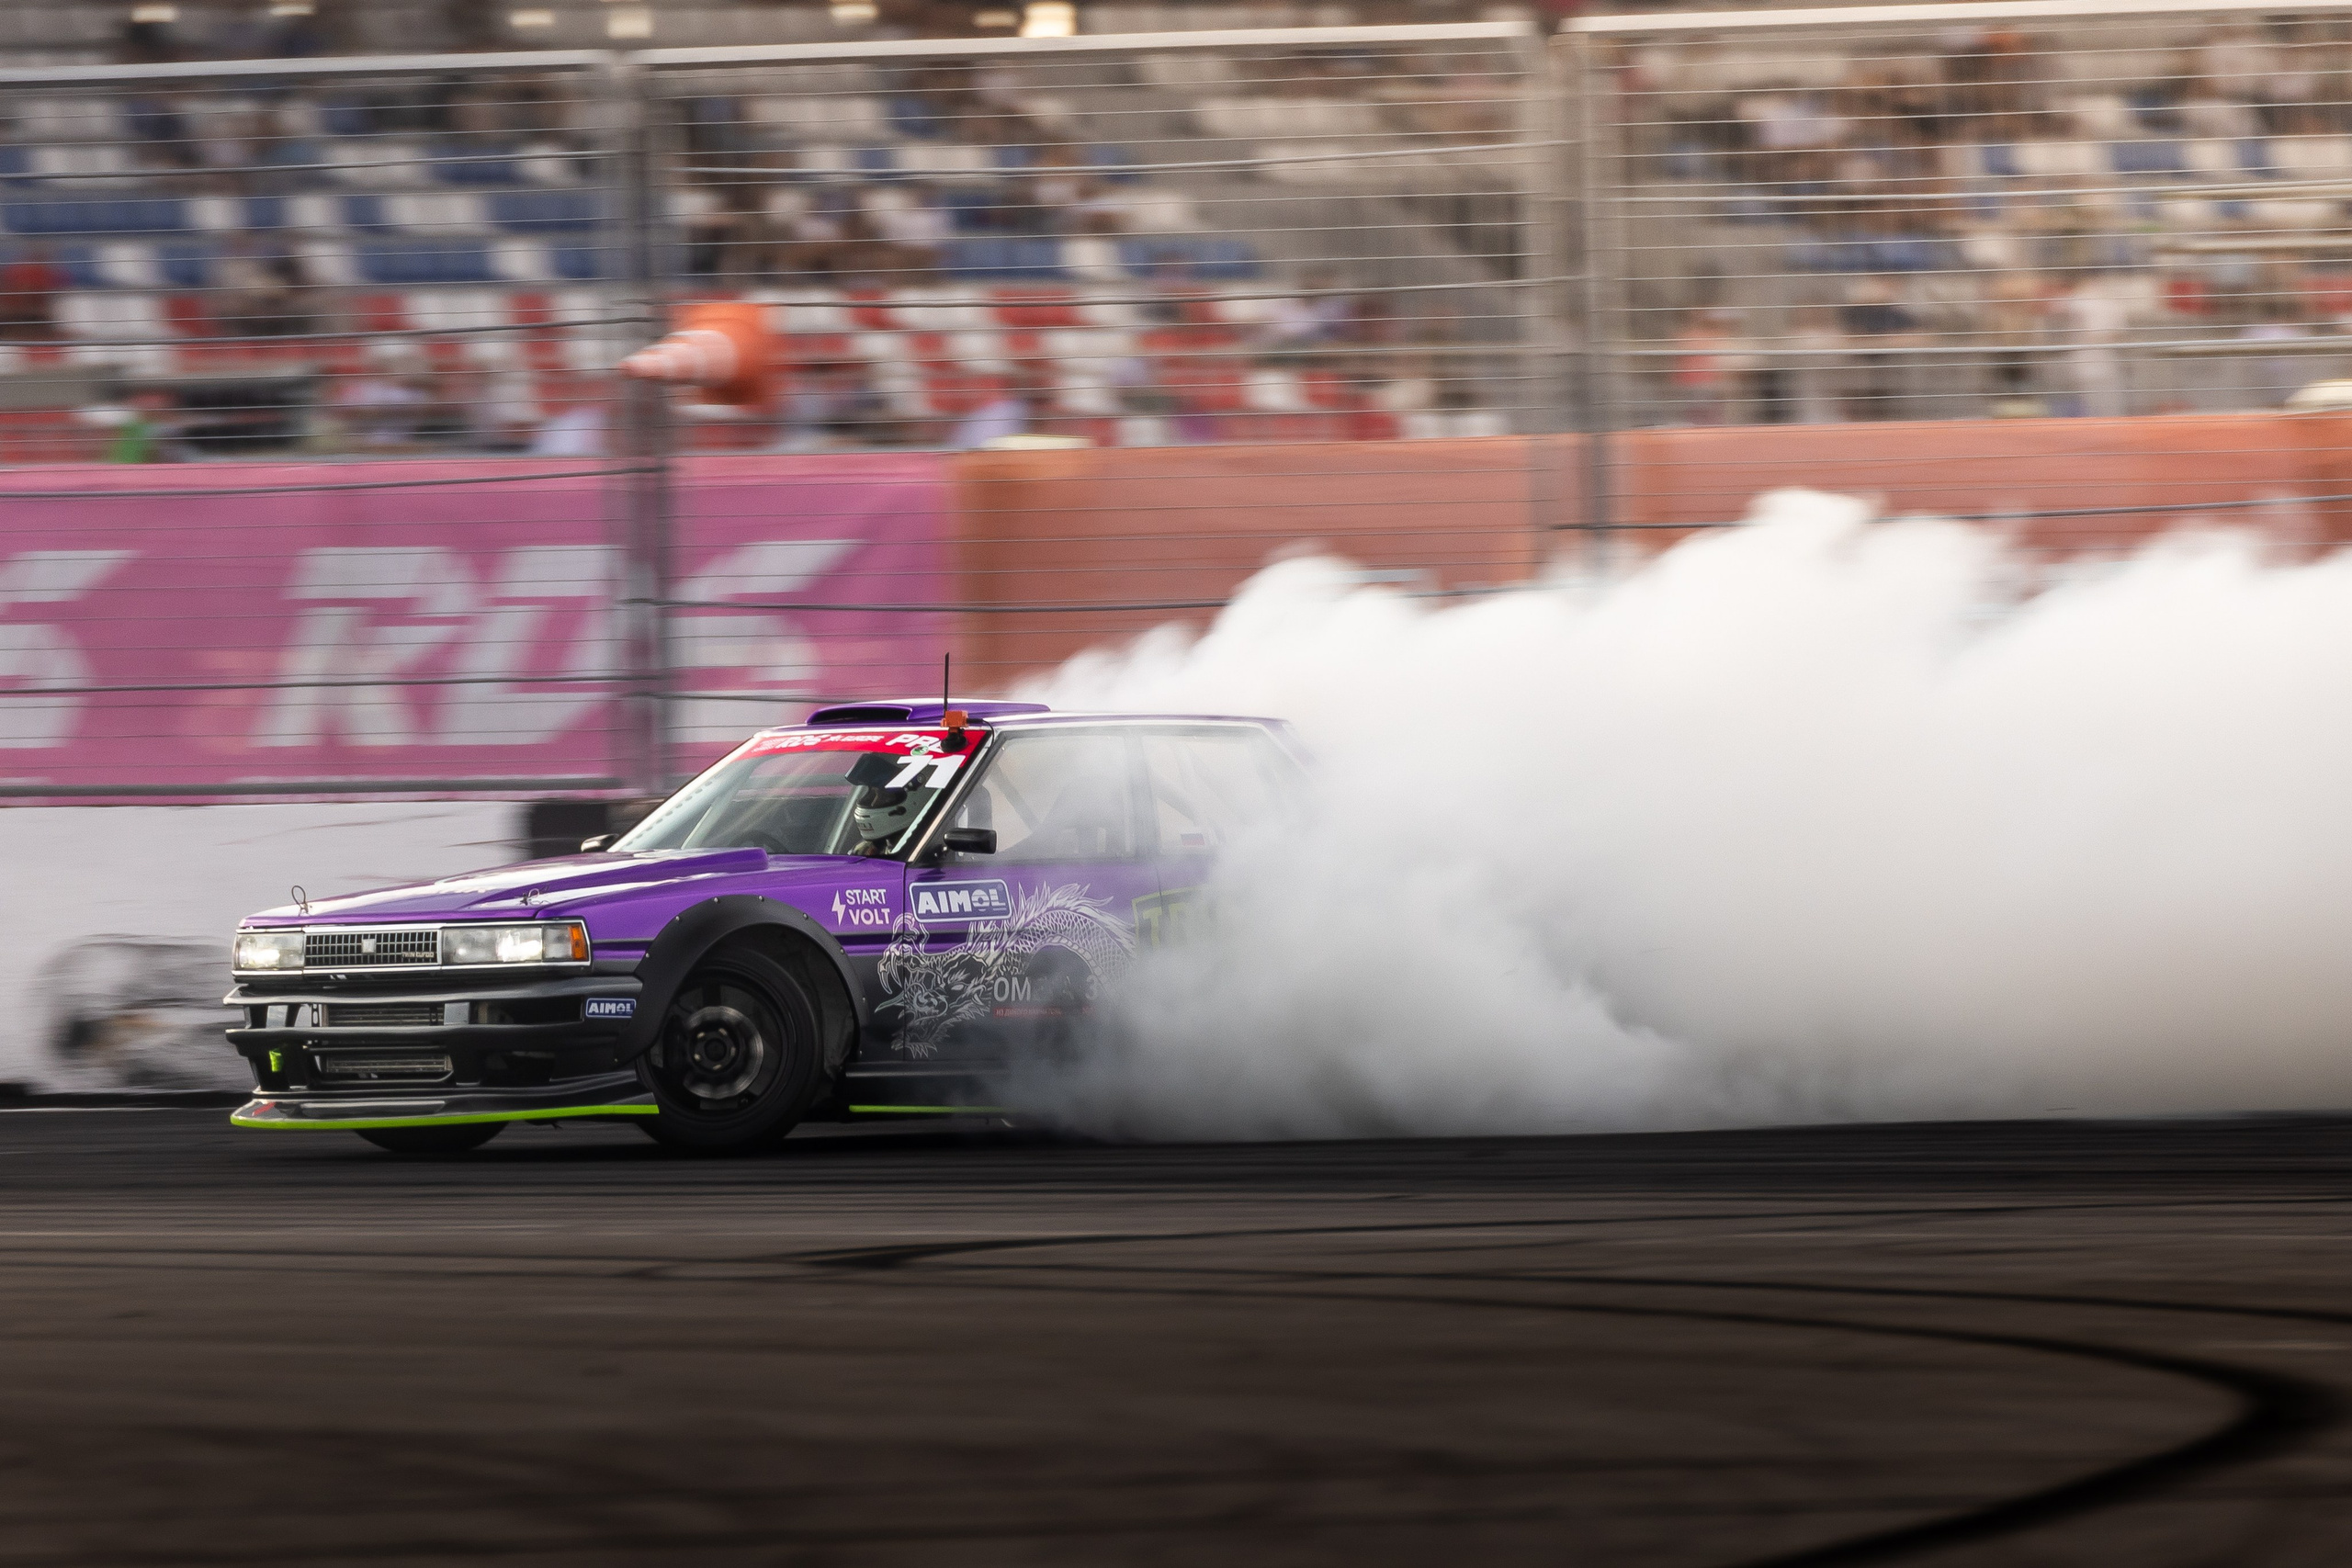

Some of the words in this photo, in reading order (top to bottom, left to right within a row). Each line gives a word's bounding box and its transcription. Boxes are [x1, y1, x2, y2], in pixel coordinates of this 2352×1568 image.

[885, 754, 966, 788] 71
[845, 888, 887, 906] START
[917, 888, 1006, 915] AIMOL
[848, 908, 890, 926] VOLT
[588, 1002, 634, 1015] AIMOL
